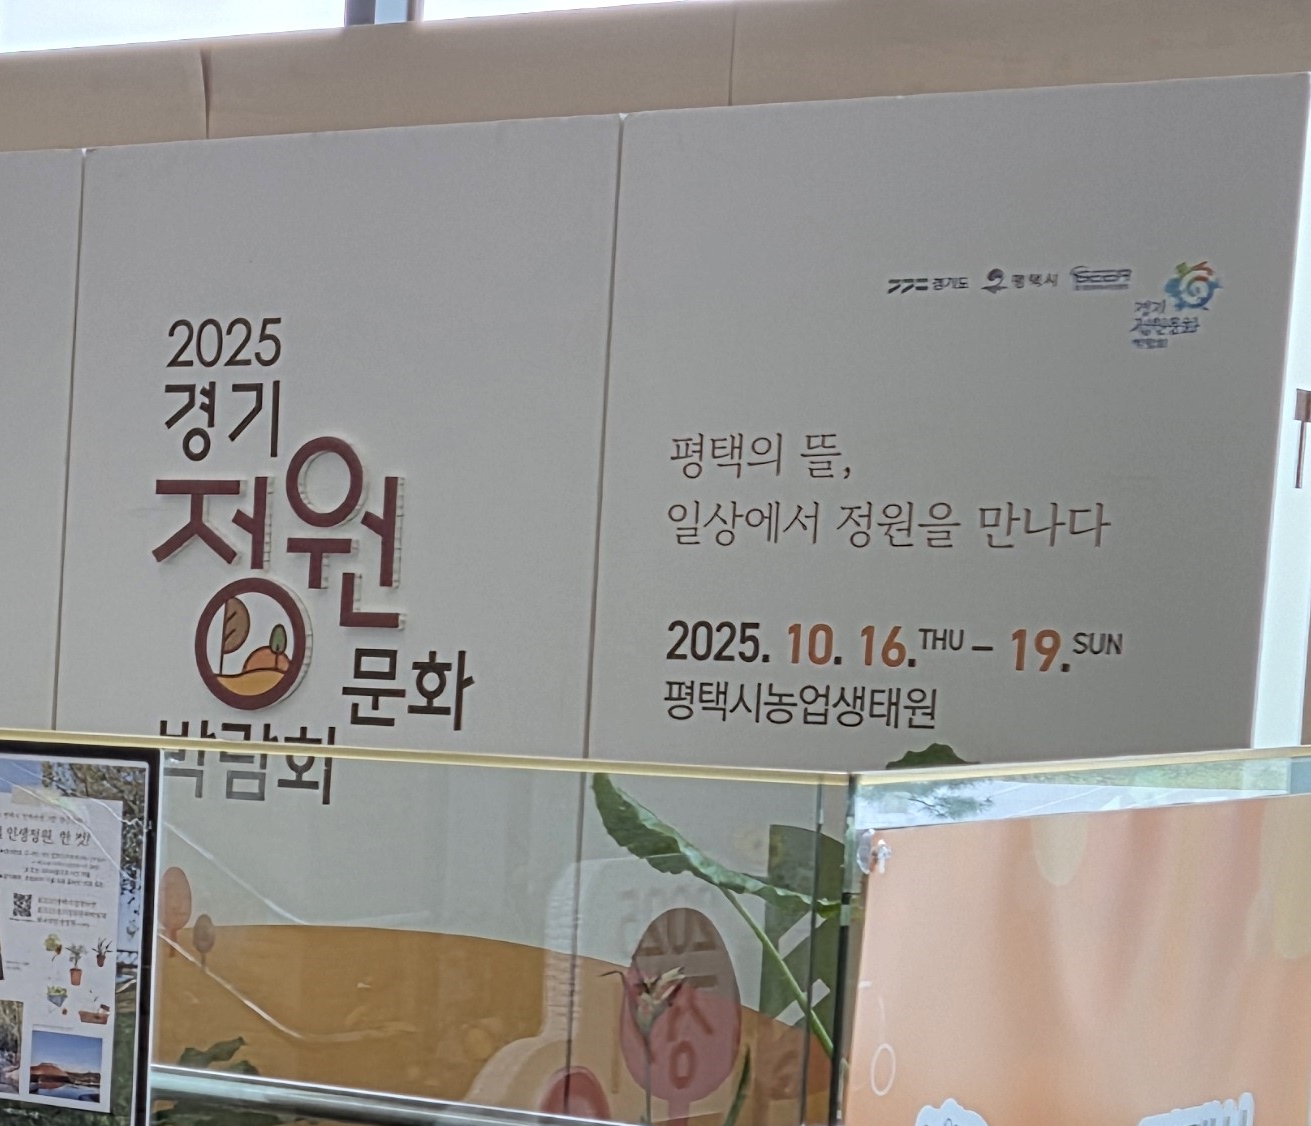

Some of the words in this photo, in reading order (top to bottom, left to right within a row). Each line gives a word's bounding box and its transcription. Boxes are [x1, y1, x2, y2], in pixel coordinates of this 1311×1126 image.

[166, 317, 282, 368] 2025
[164, 380, 281, 461] 경기
[670, 432, 783, 479] 평택의
[800, 433, 852, 479] 뜰,
[667, 500, 820, 547] 일상에서
[836, 500, 961, 549] 정원을
[978, 501, 1112, 549] 만나다
[151, 435, 404, 711] 정원
[665, 620, 771, 663] 2025.
[787, 623, 842, 666] 10.
[342, 648, 475, 731] 문화
[664, 679, 938, 730] 평택시농업생태원
[159, 719, 336, 806] 박람회
